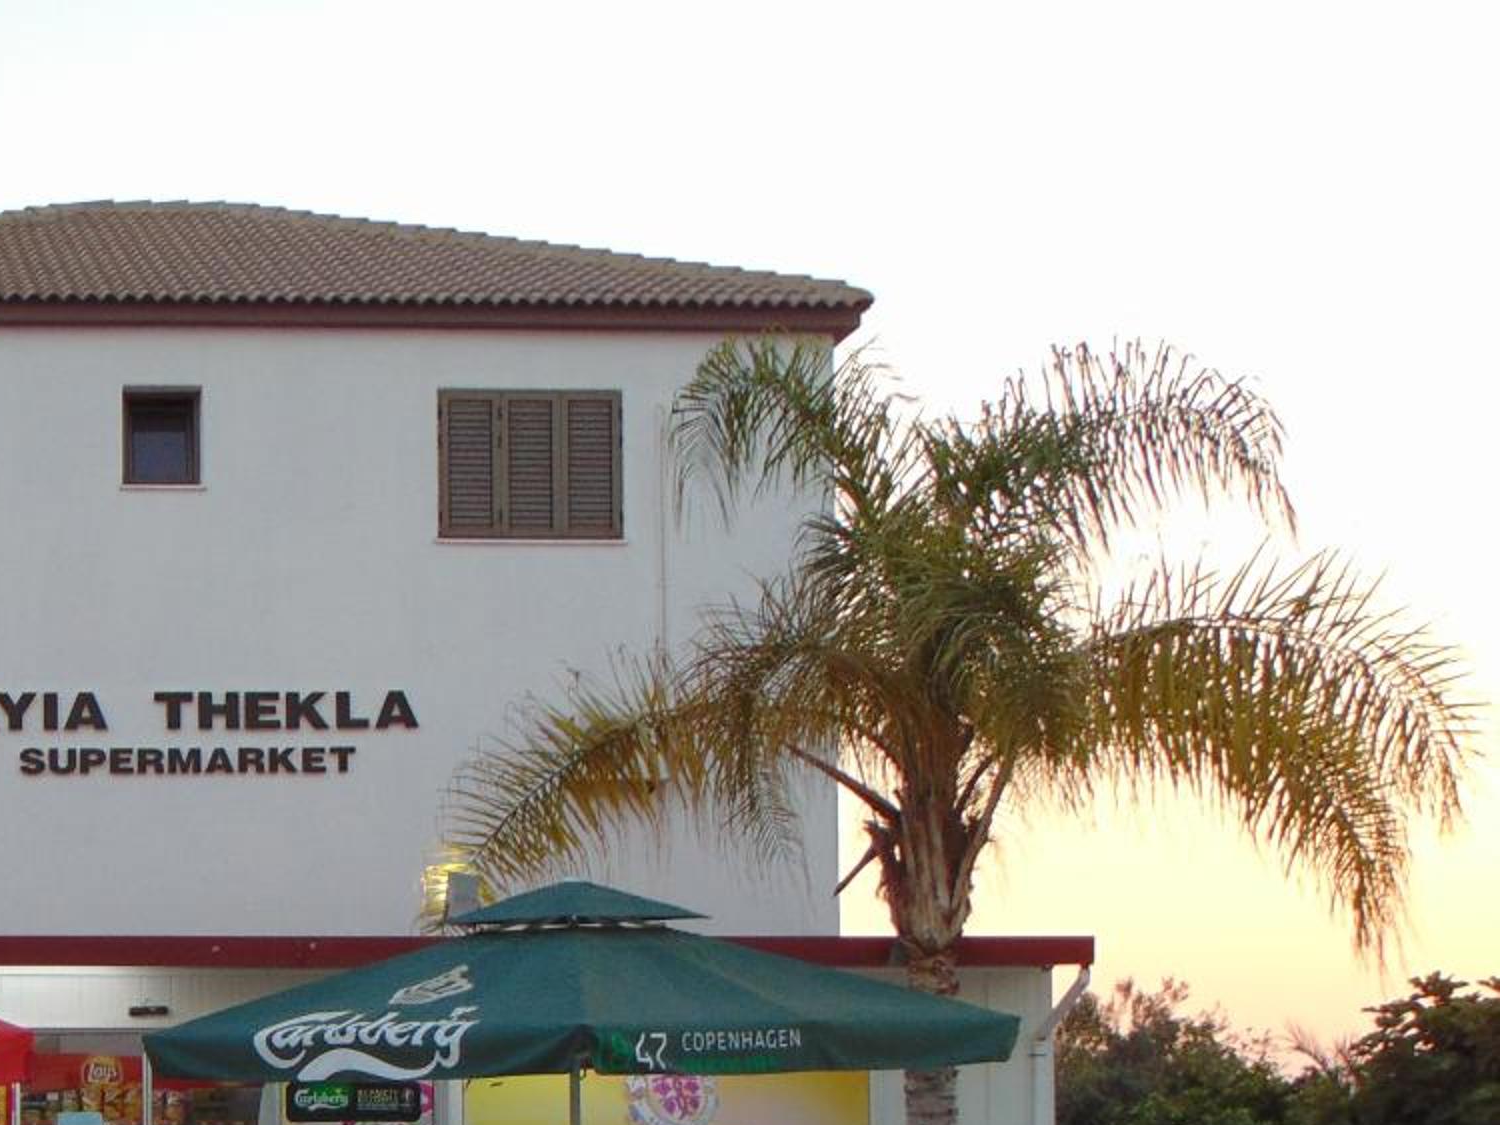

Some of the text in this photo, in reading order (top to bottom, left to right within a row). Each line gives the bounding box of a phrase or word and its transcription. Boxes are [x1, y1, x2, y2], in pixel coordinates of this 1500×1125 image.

[154, 689, 420, 731] THEKLA
[19, 746, 357, 776] SUPERMARKET
[253, 1006, 481, 1072] Carlsberg
[681, 1028, 802, 1052] COPENHAGEN
